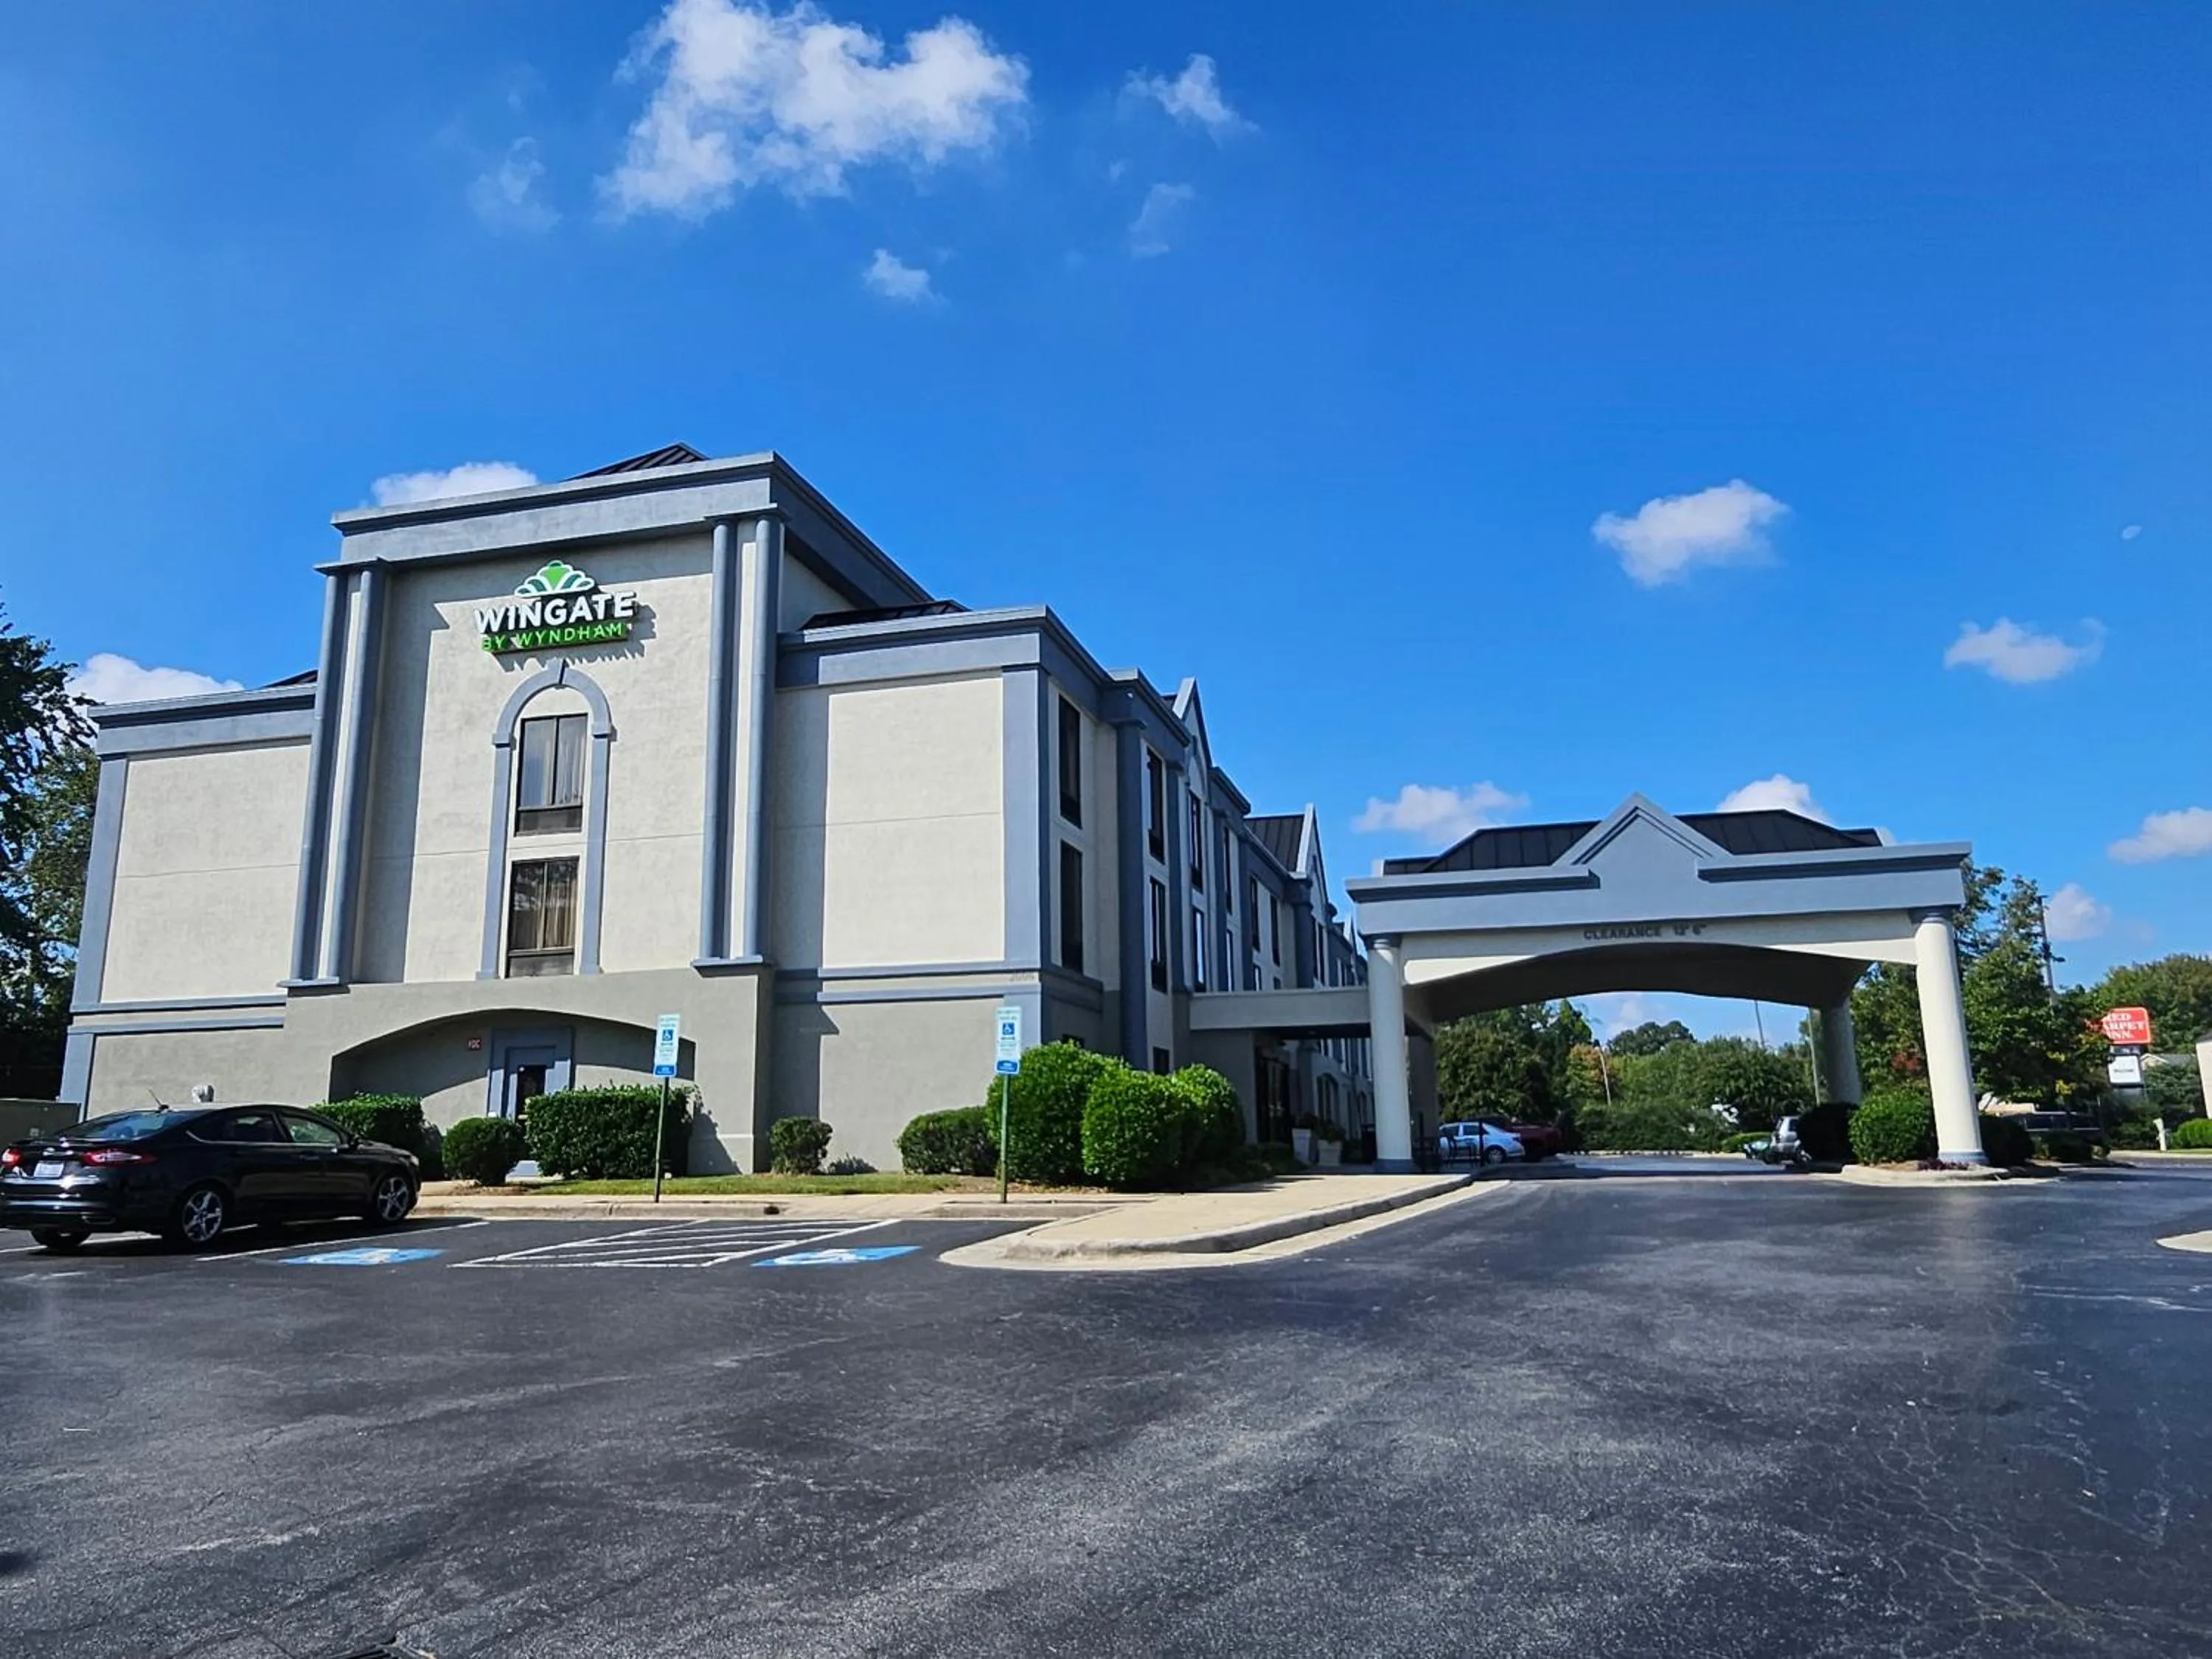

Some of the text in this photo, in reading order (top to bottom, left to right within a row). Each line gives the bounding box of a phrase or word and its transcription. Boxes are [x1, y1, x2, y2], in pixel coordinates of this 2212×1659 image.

[474, 592, 635, 633] WINGATE
[481, 622, 622, 650] BY WYNDHAM
[1584, 925, 1662, 940] CLEARANCE
